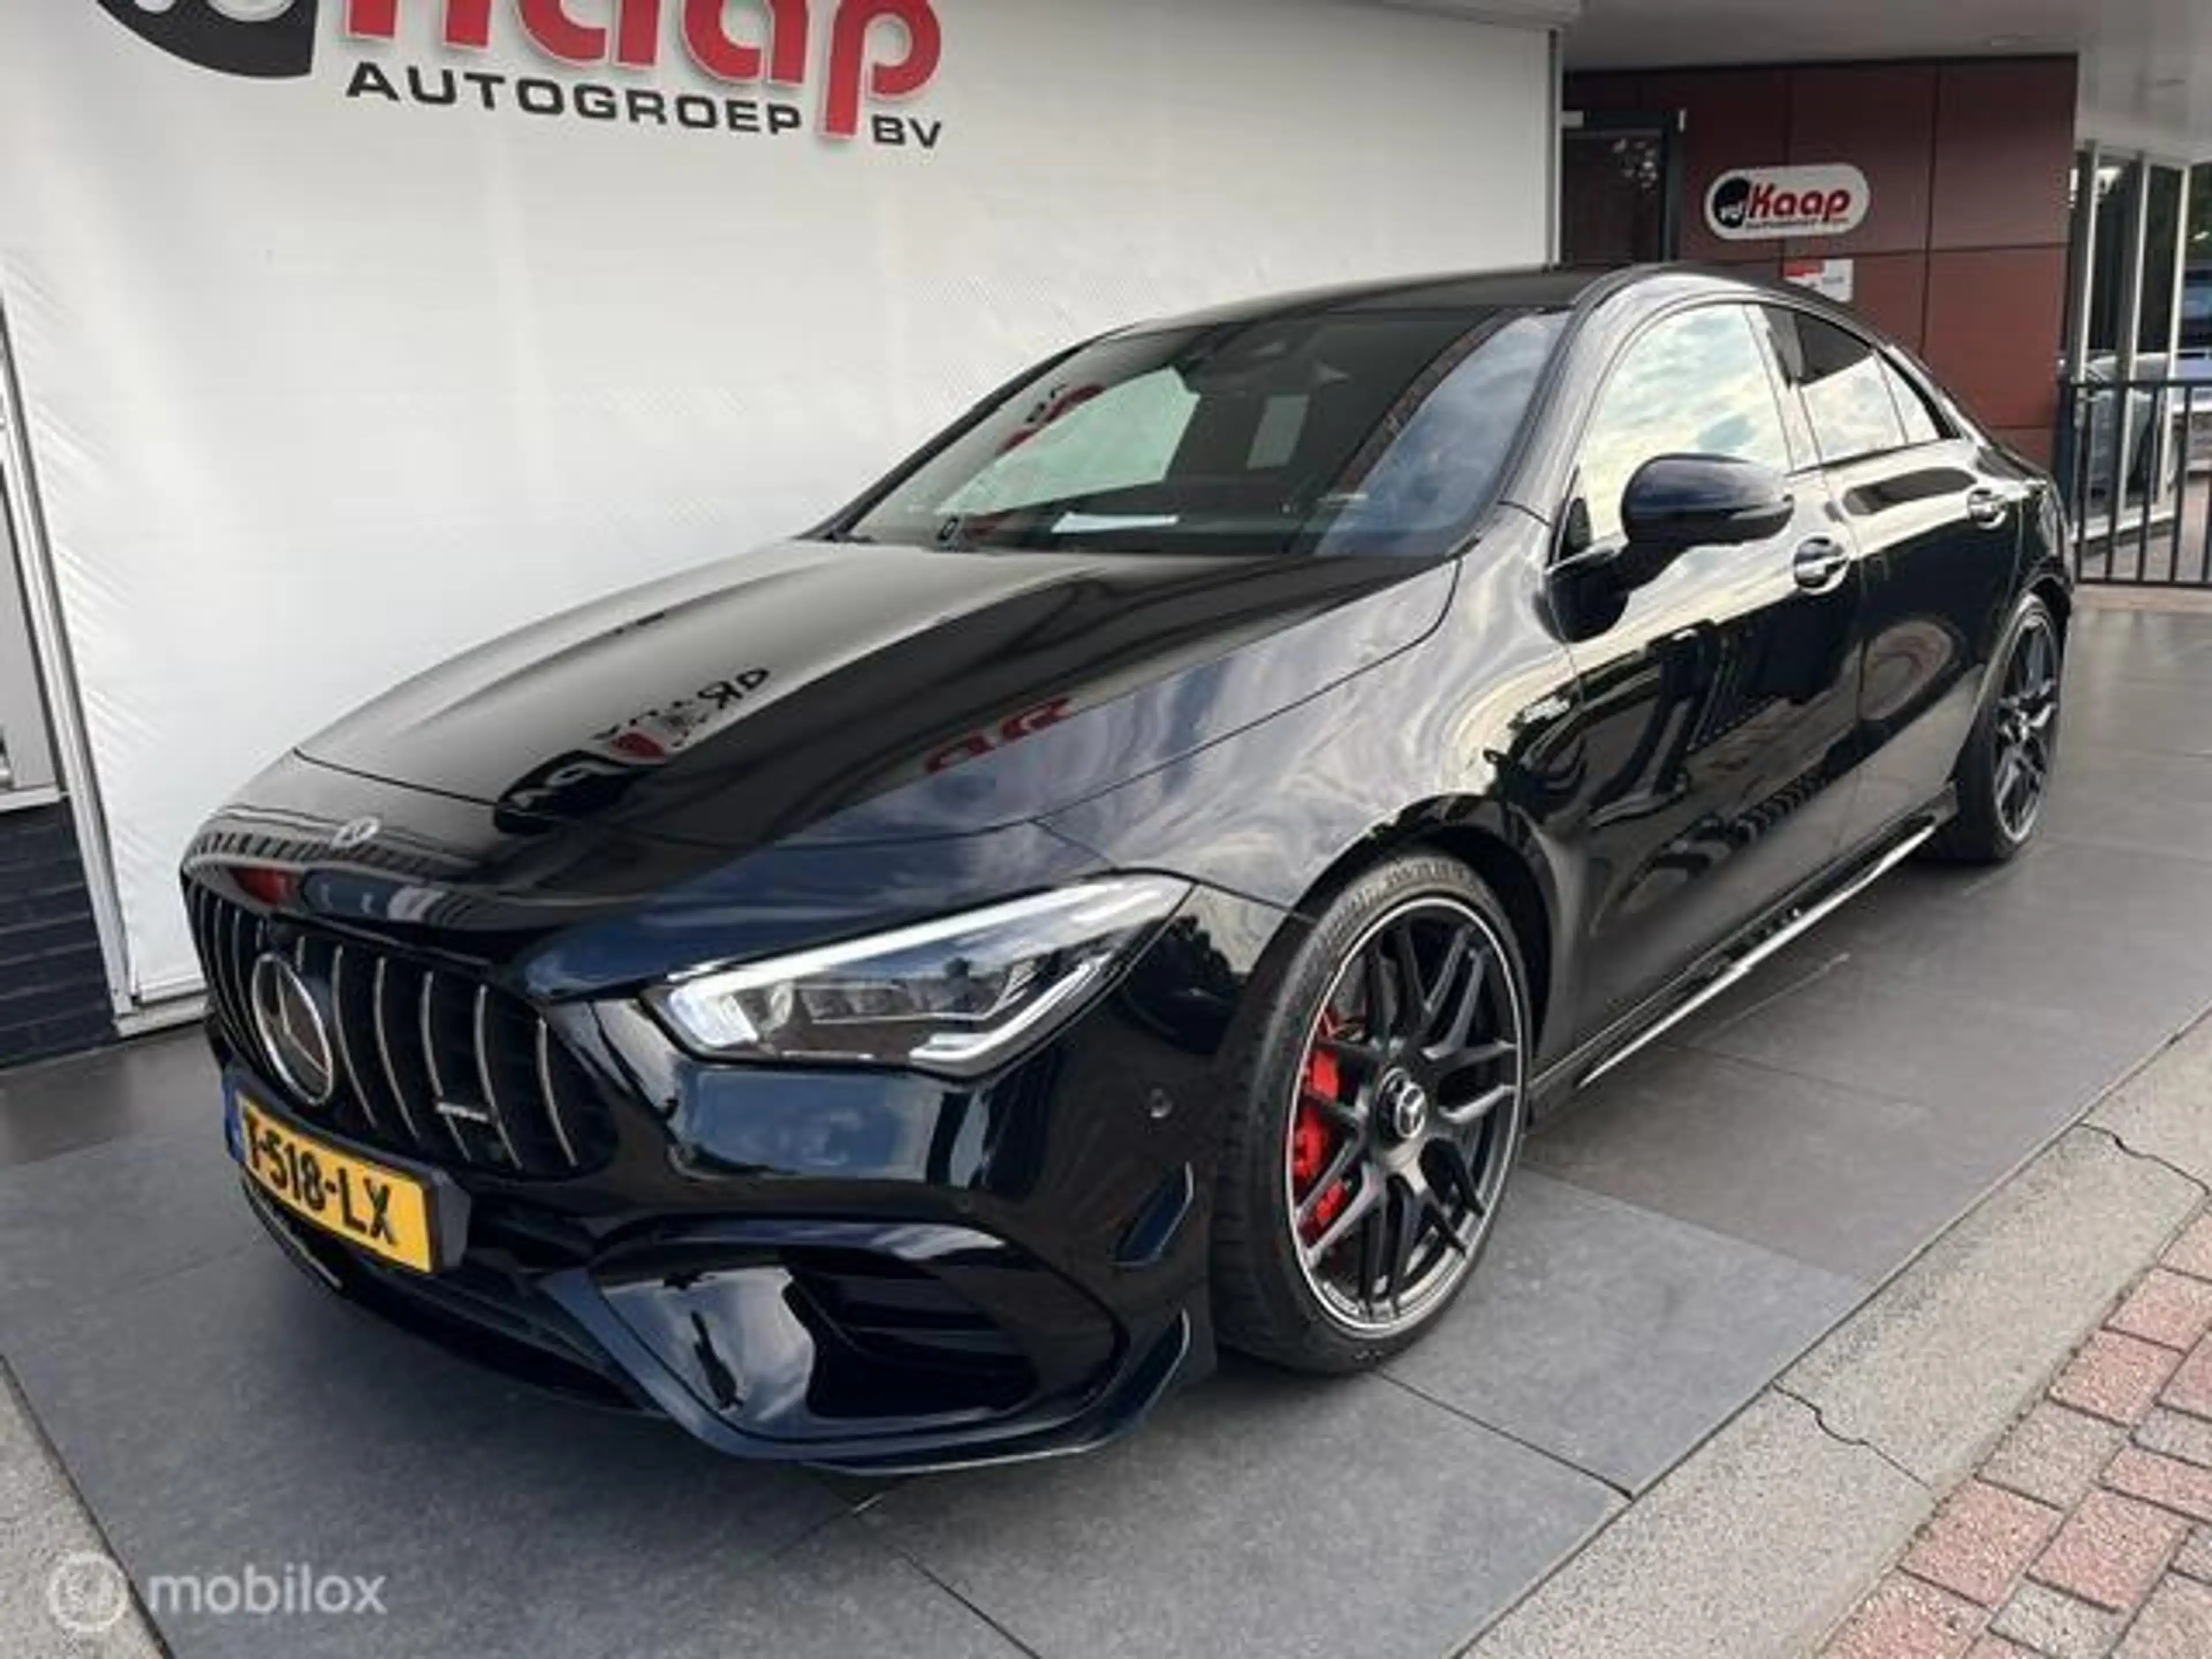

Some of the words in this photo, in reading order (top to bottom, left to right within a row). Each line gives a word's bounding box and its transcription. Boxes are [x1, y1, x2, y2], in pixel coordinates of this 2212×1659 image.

[346, 61, 801, 134] AUTOGROEP
[872, 115, 942, 149] BV
[1749, 183, 1851, 222] Kaap
